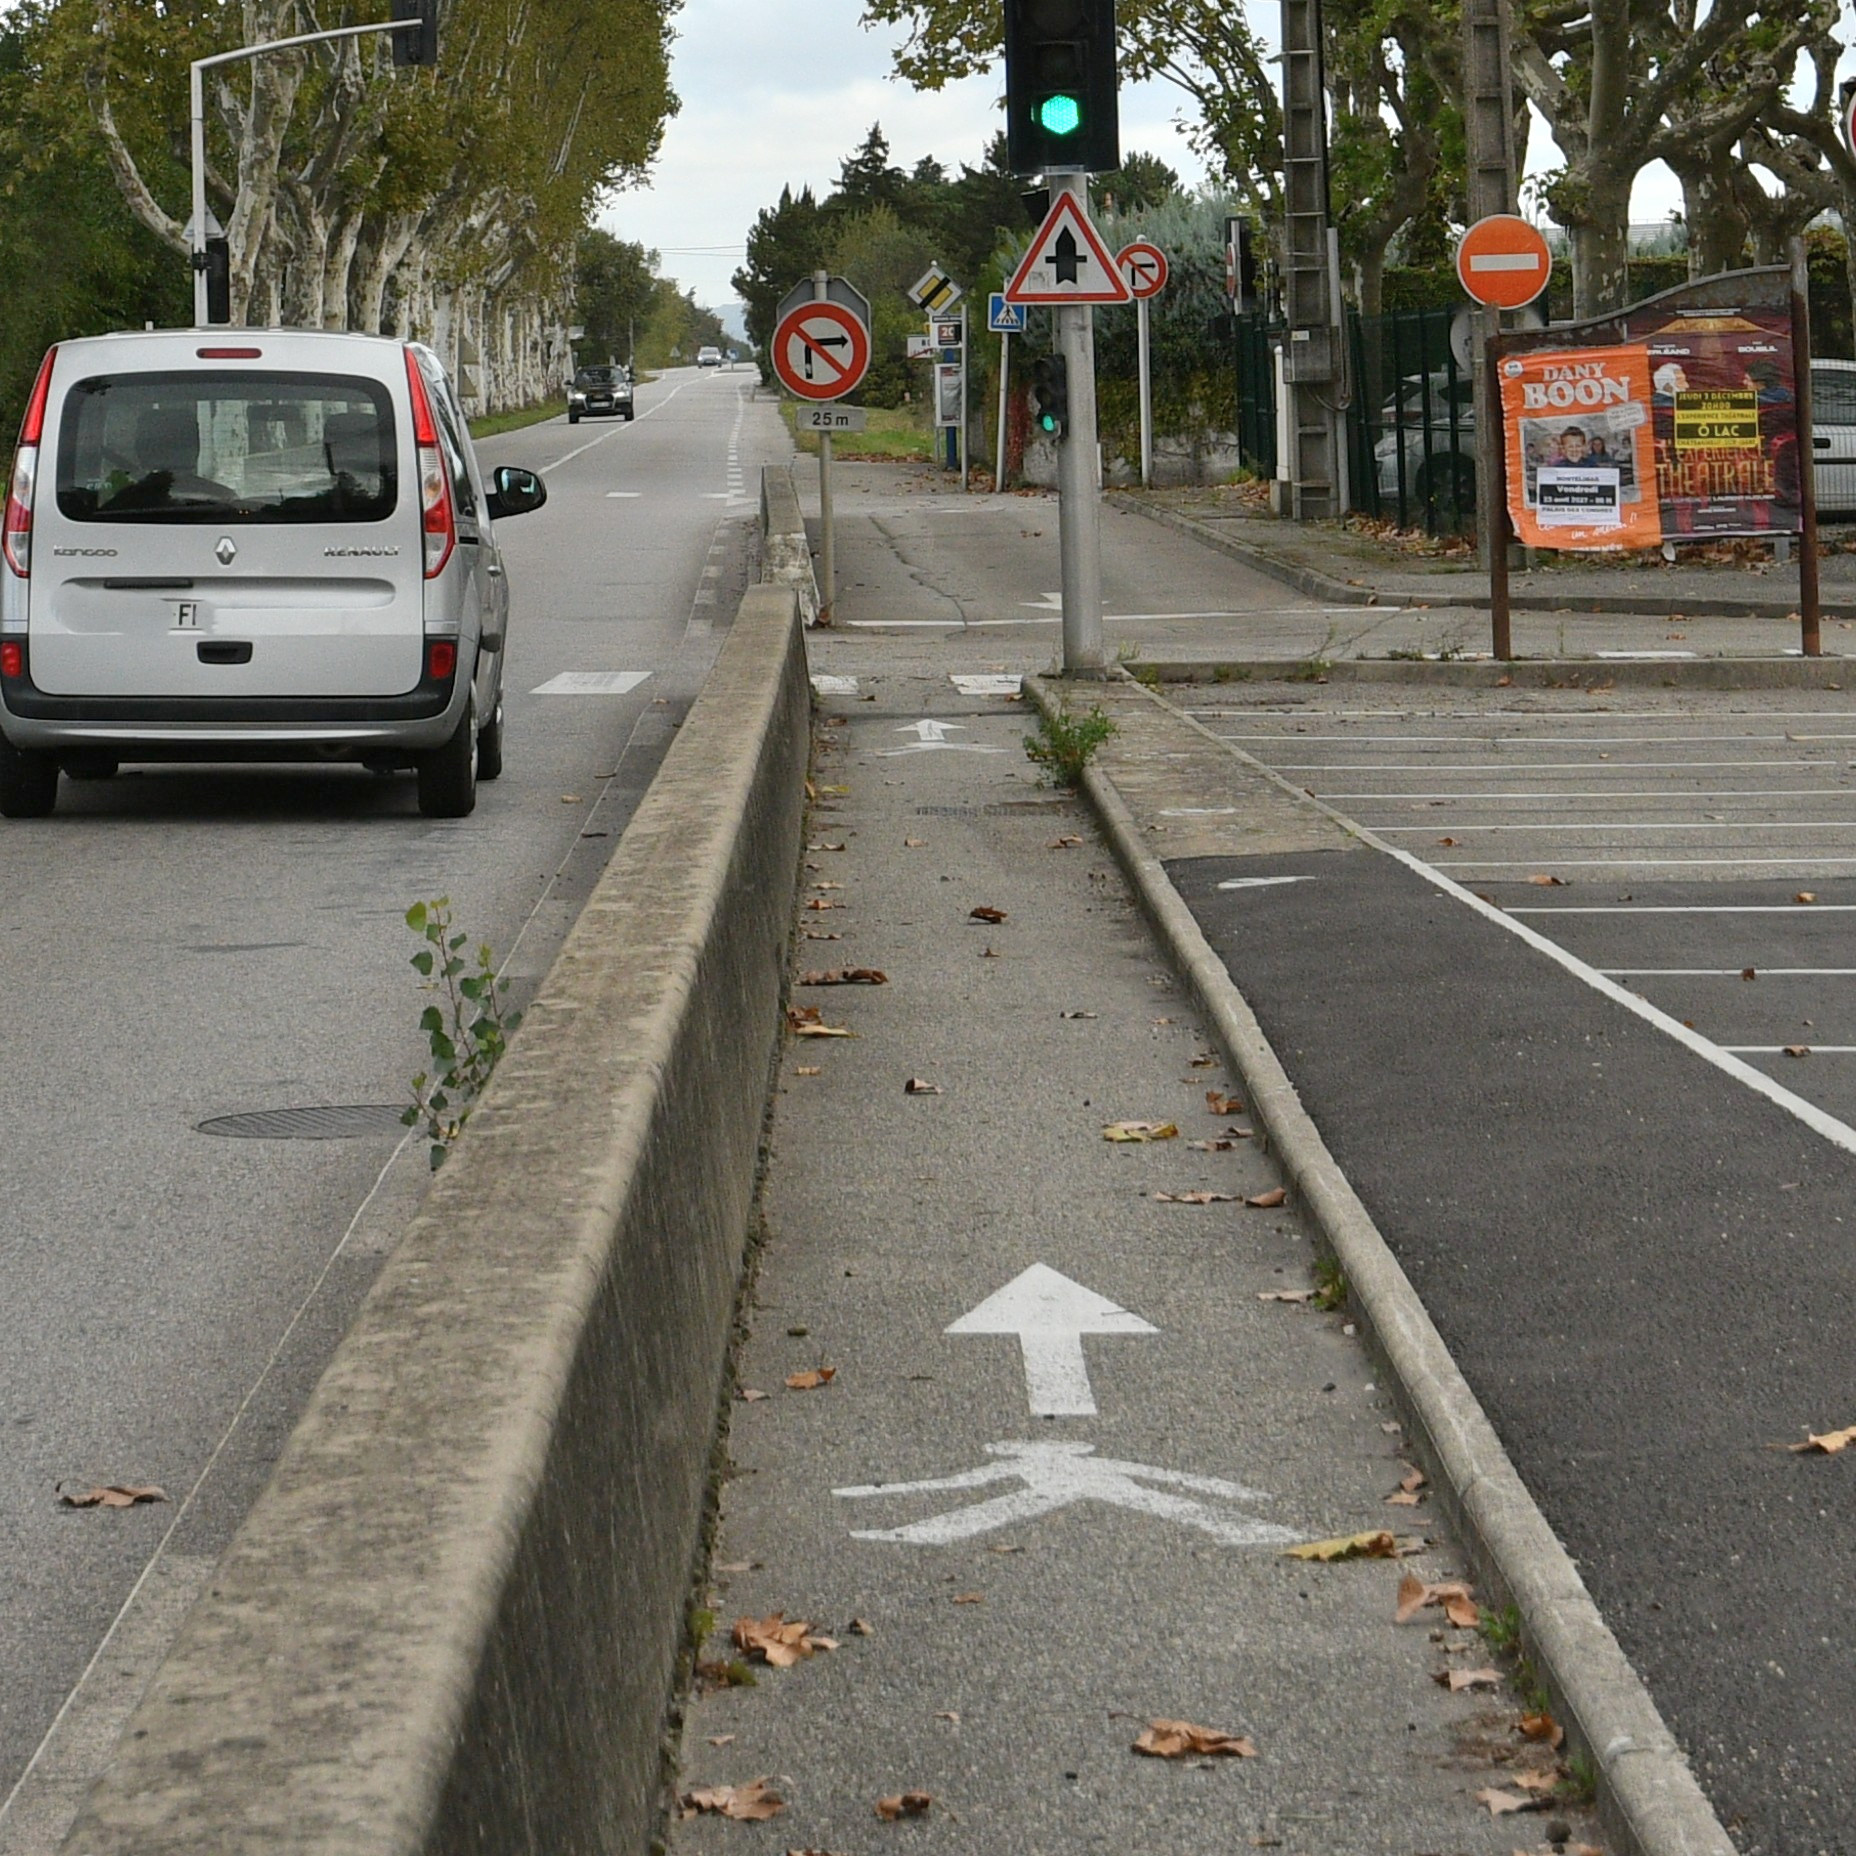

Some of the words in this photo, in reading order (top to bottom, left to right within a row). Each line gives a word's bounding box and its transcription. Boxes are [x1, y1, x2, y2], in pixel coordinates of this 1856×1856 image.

[1543, 362, 1607, 381] DANY
[1522, 376, 1631, 409] BOON
[812, 412, 832, 426] 25
[836, 416, 849, 426] m
[1714, 425, 1740, 437] LAC
[323, 545, 401, 557] RENAULT
